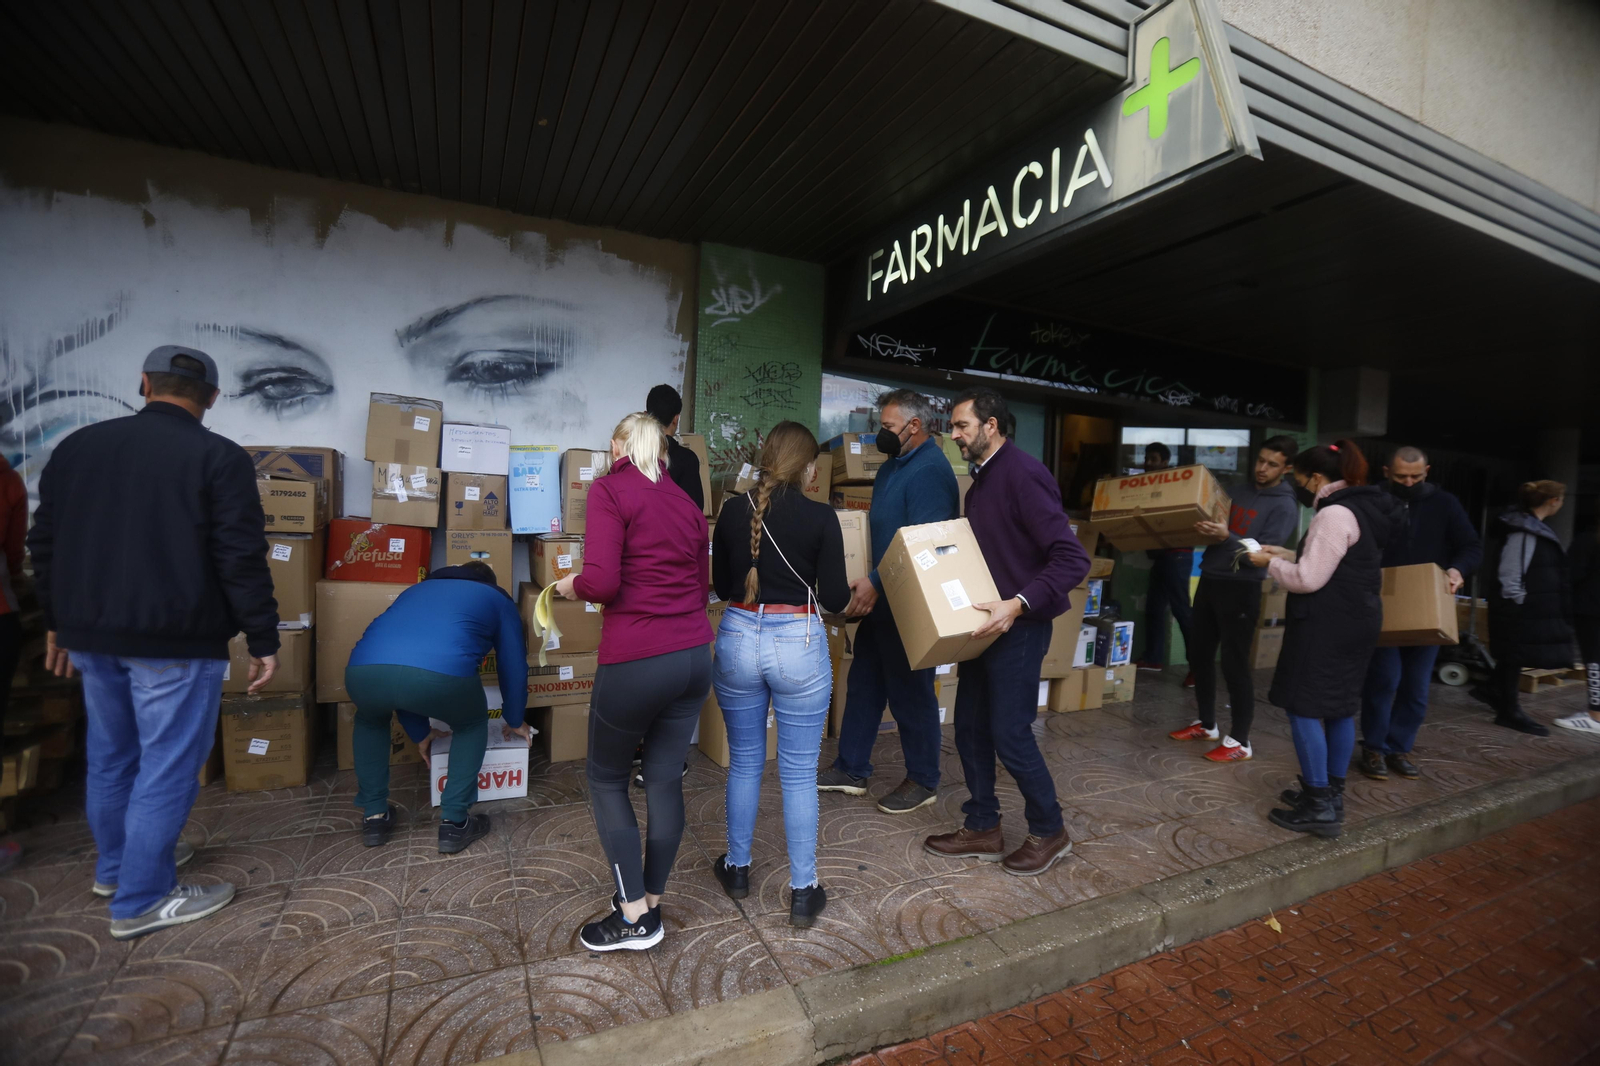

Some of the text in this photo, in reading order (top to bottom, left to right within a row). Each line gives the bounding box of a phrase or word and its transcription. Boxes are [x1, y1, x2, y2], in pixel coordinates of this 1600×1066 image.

[866, 127, 1112, 301] FARMACIA
[513, 466, 542, 478] BABY
[1119, 469, 1194, 490] POLVILLO
[270, 490, 307, 498] 21792452
[551, 516, 559, 526] 4
[527, 680, 595, 693] MACARRONES
[1587, 663, 1600, 705] adidas
[620, 925, 647, 937] FILA
